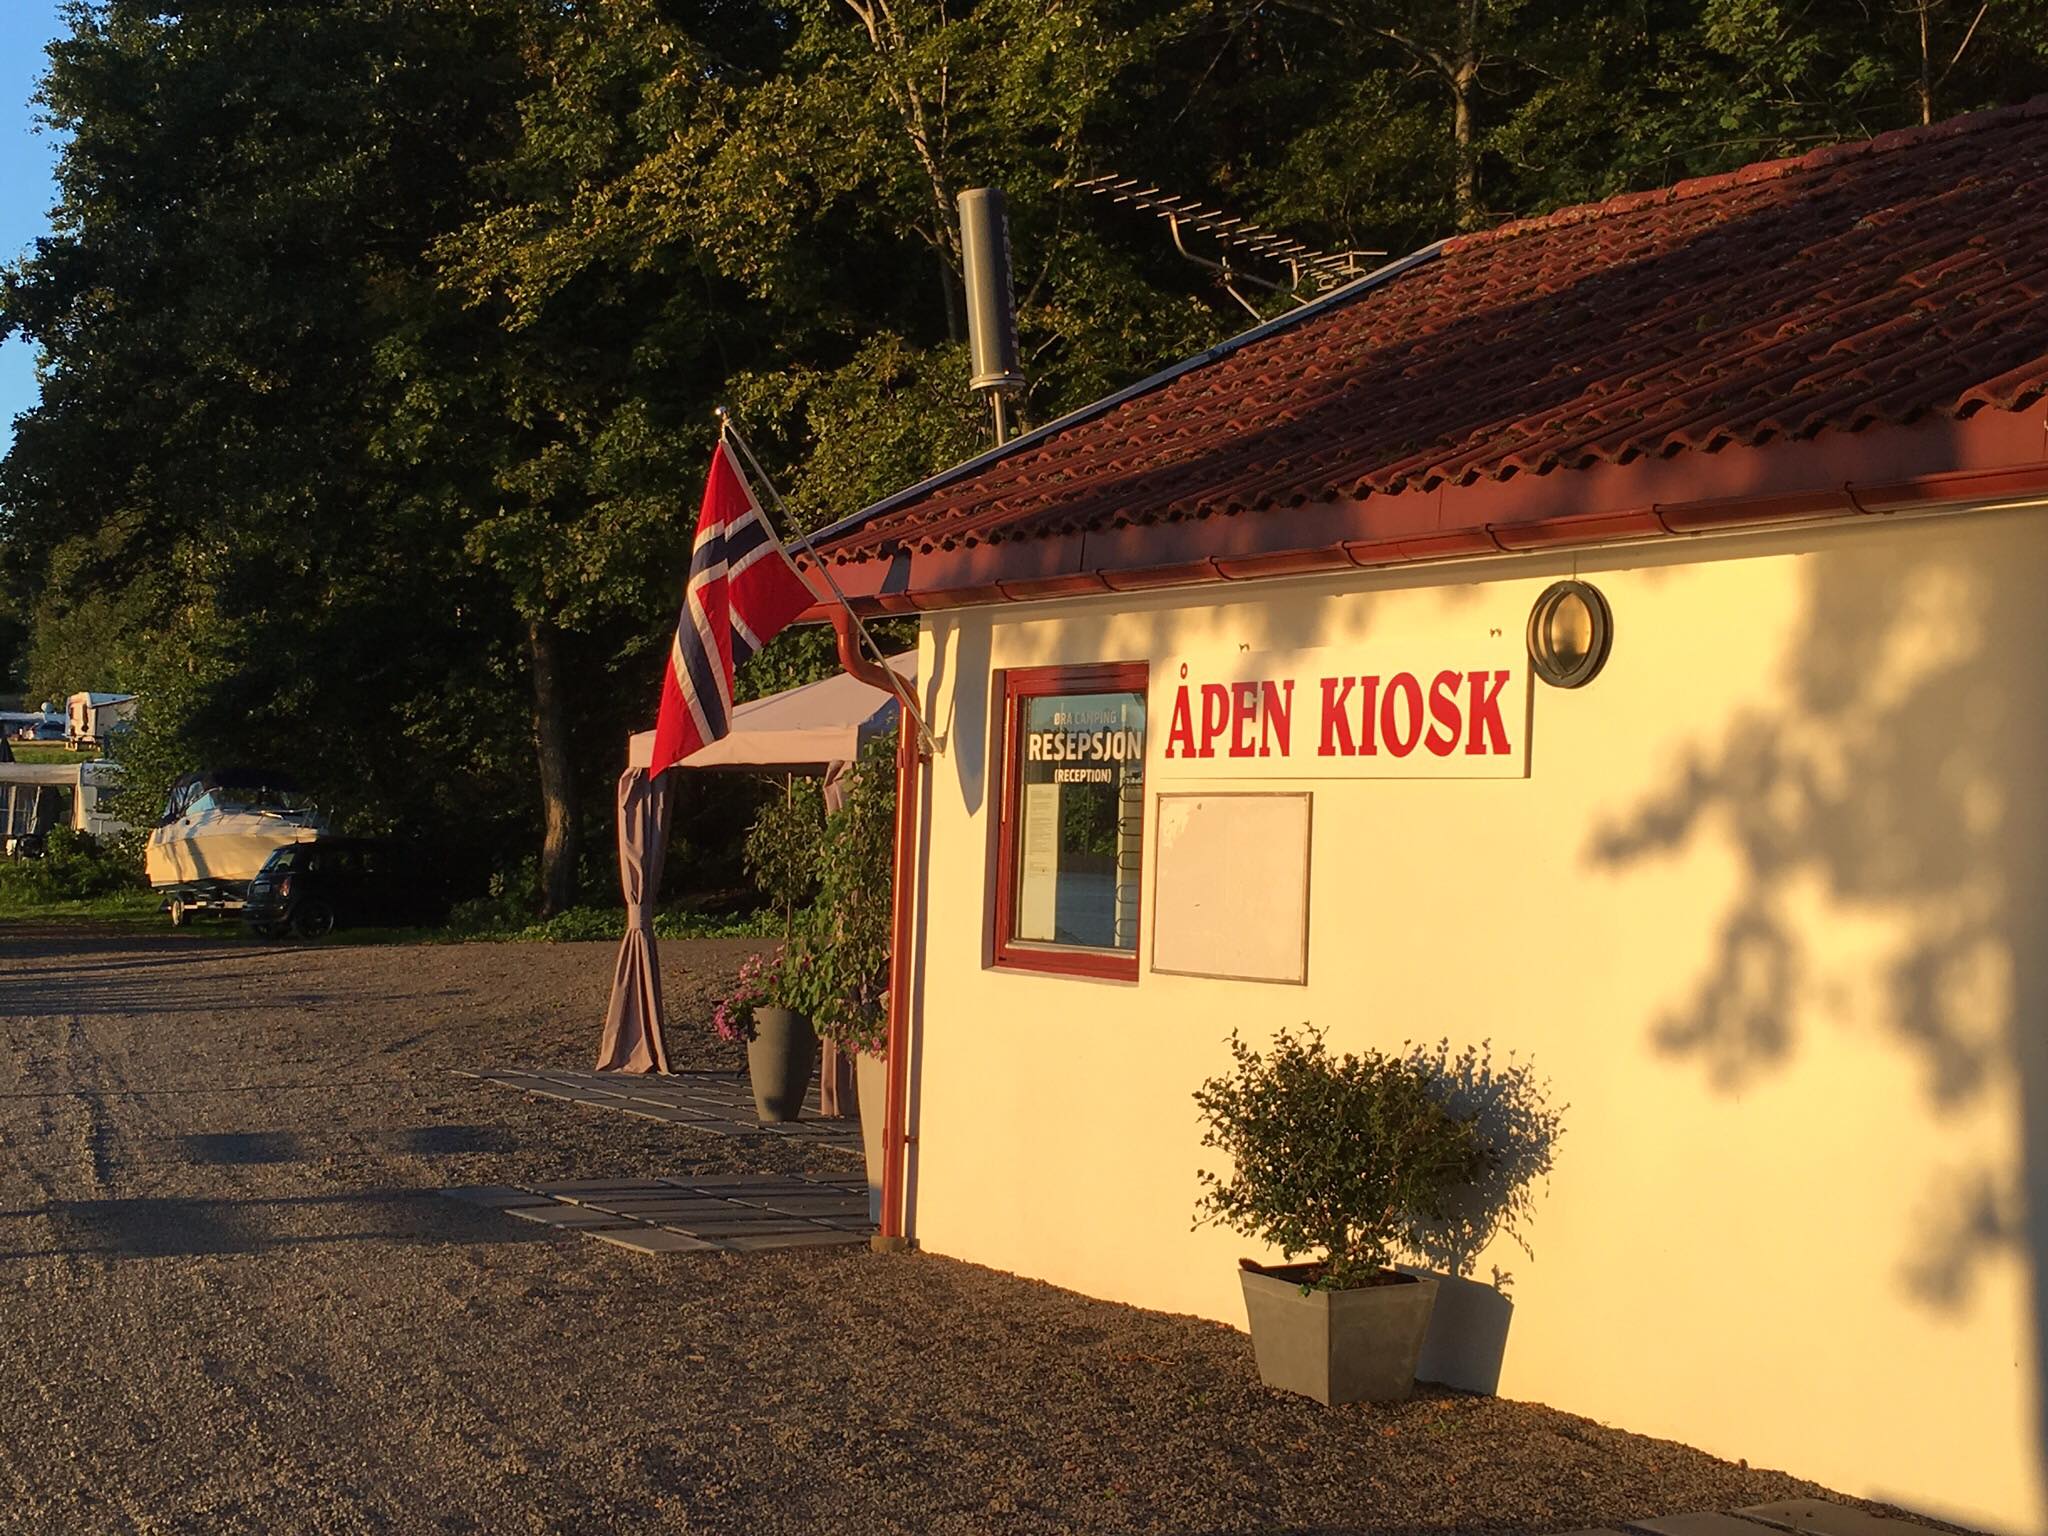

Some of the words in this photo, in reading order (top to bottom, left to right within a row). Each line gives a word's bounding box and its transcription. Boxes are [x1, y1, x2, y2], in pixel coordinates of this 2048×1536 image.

[1075, 711, 1117, 725] CAMPING
[1165, 662, 1294, 758] ÅPEN
[1317, 669, 1511, 758] KIOSK
[1028, 732, 1142, 762] RESEPSJON
[1054, 768, 1112, 783] (RECEPTION)
